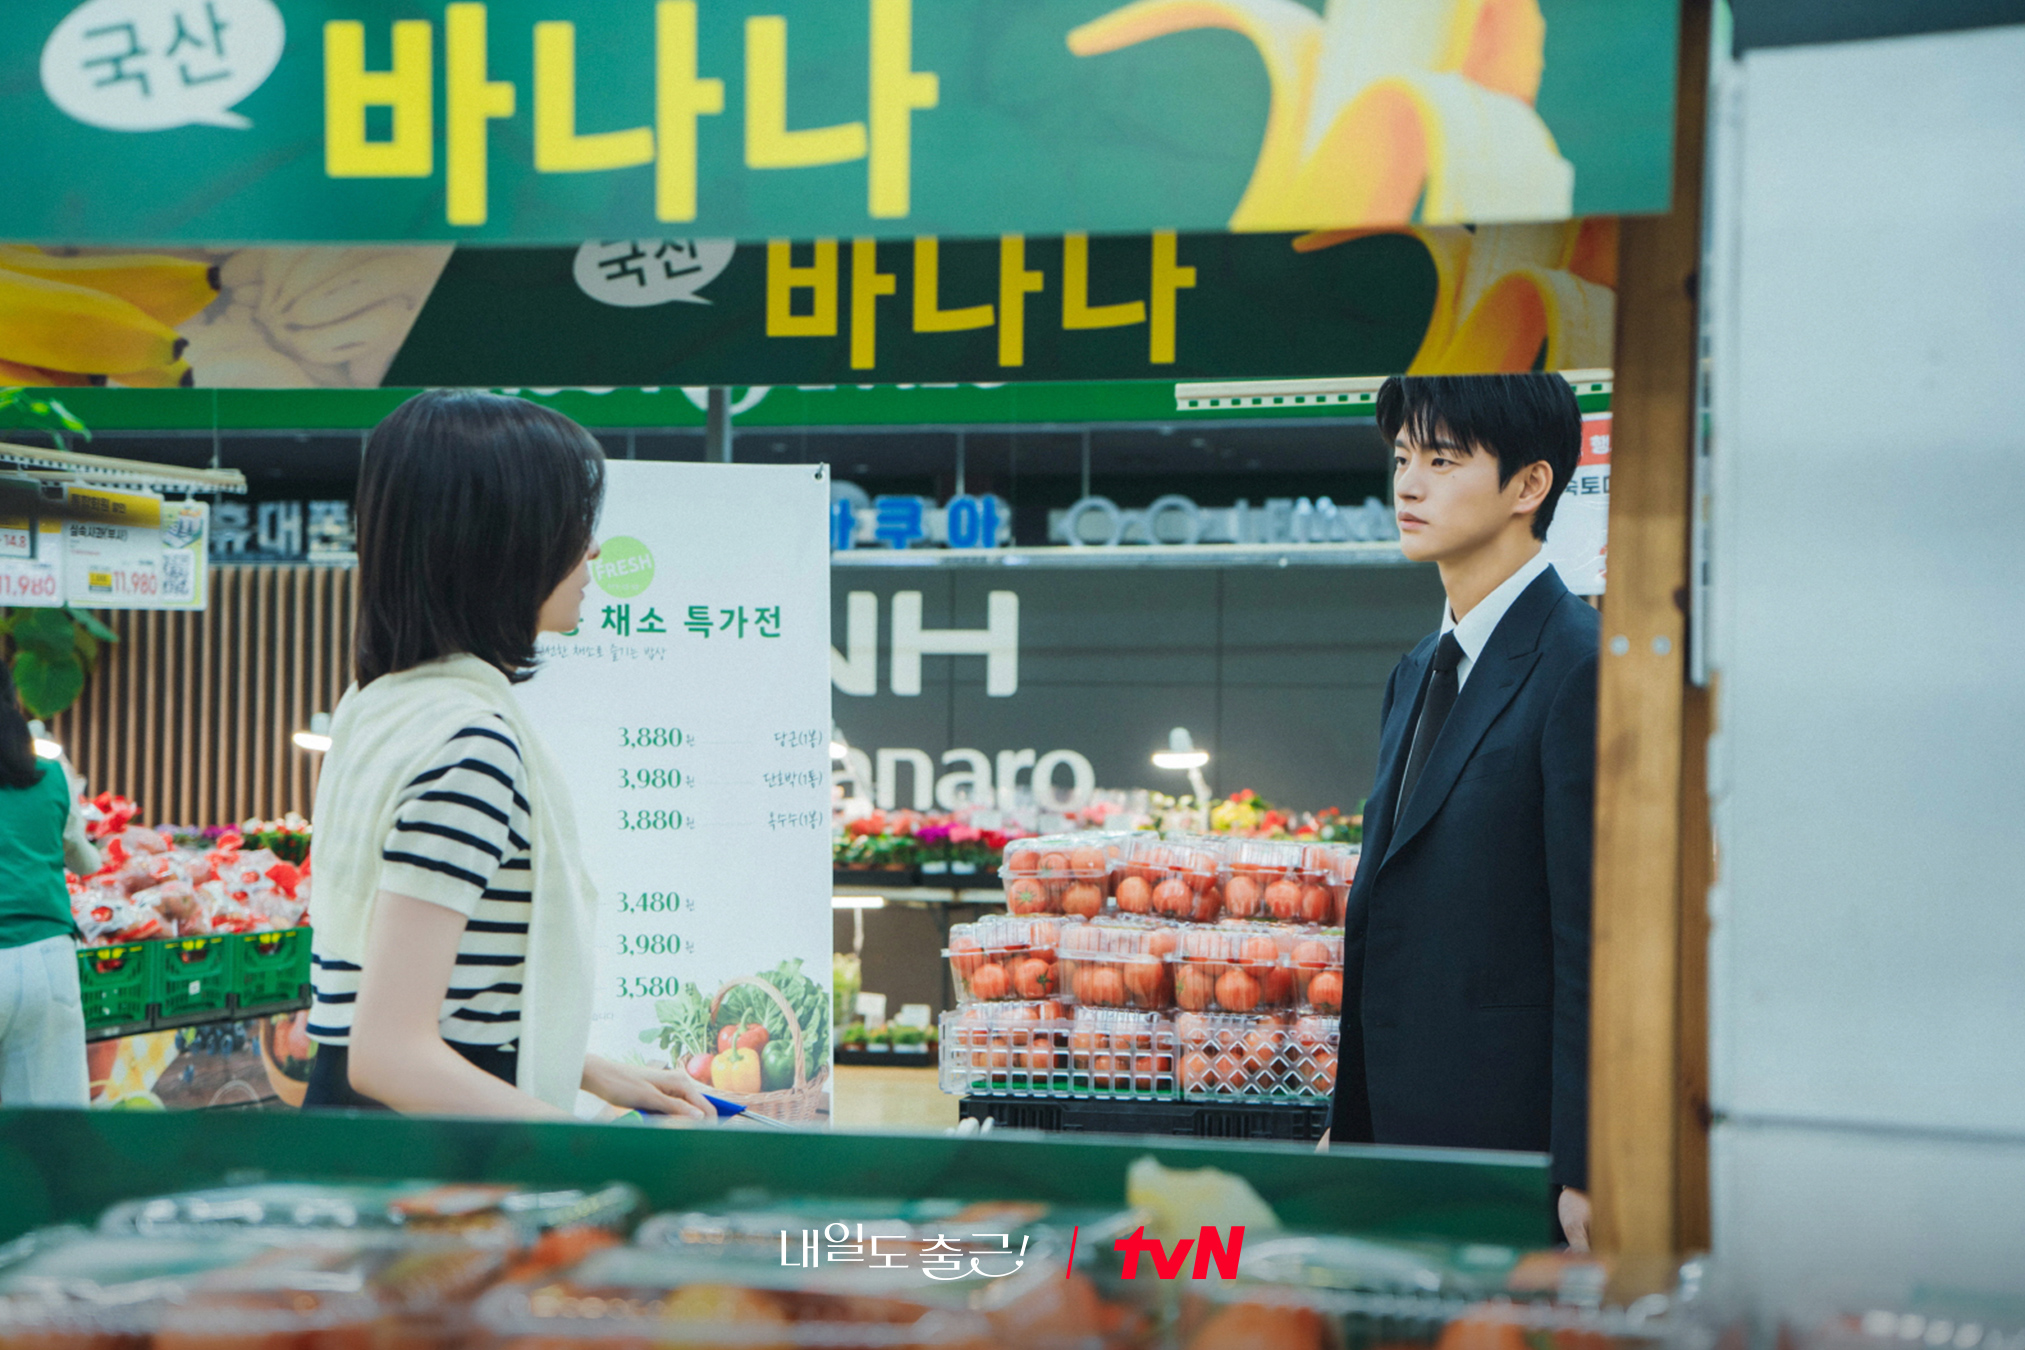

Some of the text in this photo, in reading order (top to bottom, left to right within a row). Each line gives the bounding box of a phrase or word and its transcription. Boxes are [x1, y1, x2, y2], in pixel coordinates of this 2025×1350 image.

[81, 0, 939, 225] 국산 바나나
[598, 232, 1196, 369] 국산 바나나
[595, 553, 653, 580] FRESH
[601, 603, 667, 637] 채소
[684, 605, 782, 639] 특가전
[610, 643, 639, 662] 즐기는
[644, 645, 667, 661] 밥상
[617, 727, 683, 749] 3,880
[773, 729, 823, 749] 당근(1봉)
[617, 768, 682, 790] 3,980
[763, 769, 823, 789] 단호박(1통)
[617, 809, 683, 832] 3,880
[768, 810, 823, 831] 옥수수(1봉)
[616, 891, 681, 914] 3,480
[616, 934, 681, 957] 3,980
[616, 976, 680, 999] 3,580
